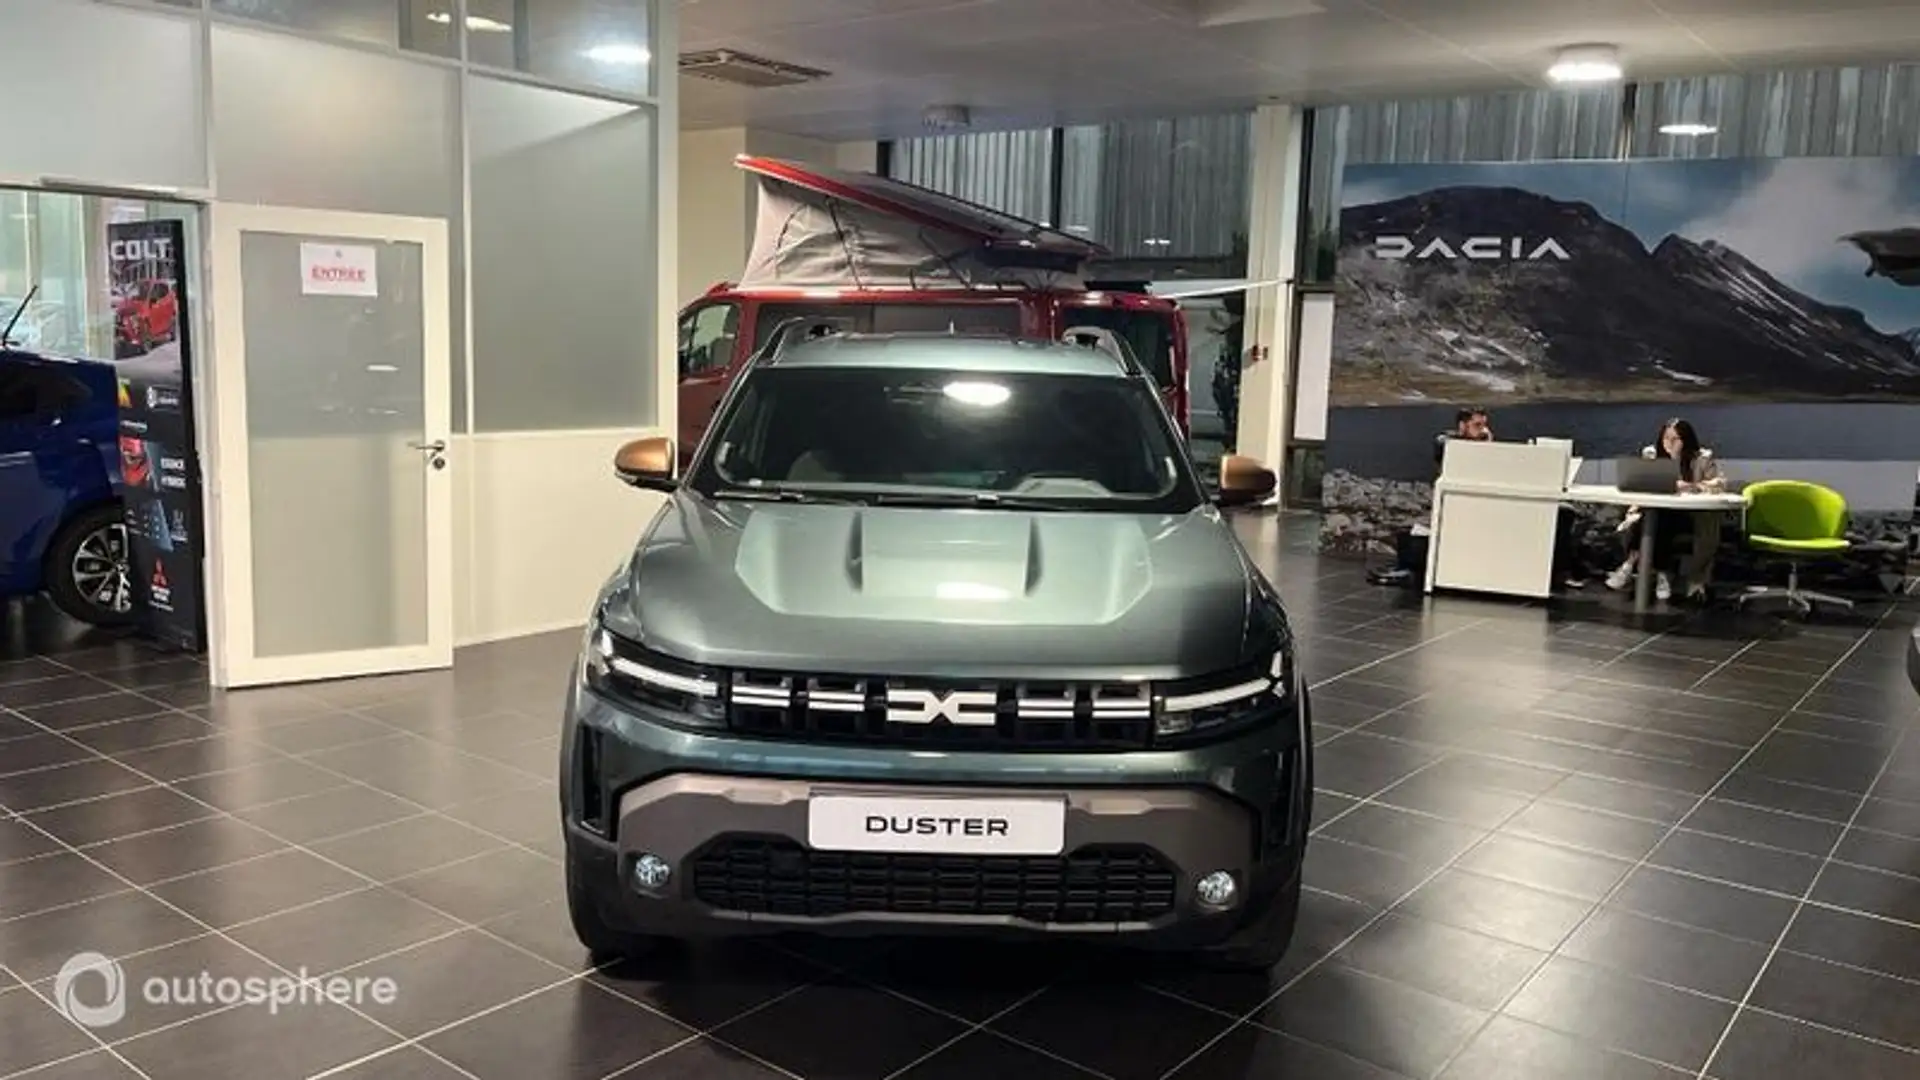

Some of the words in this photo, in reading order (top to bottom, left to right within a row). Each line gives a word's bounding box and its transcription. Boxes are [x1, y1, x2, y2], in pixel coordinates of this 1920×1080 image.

[110, 239, 171, 260] COLT
[1375, 236, 1571, 259] DACIA
[865, 815, 1009, 837] DUSTER
